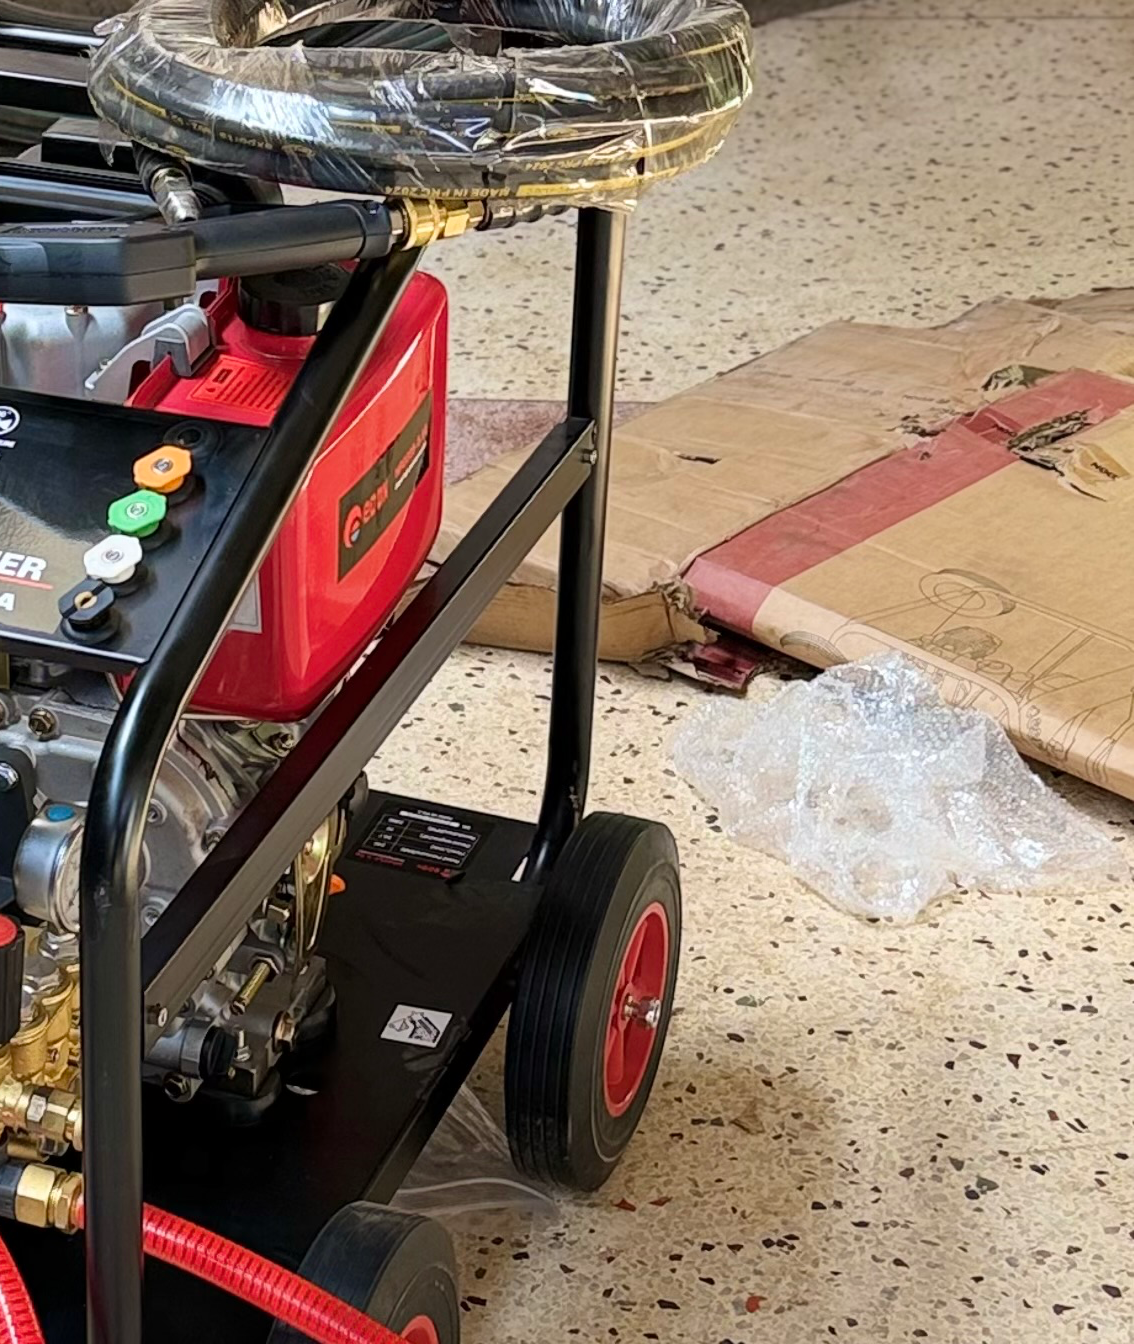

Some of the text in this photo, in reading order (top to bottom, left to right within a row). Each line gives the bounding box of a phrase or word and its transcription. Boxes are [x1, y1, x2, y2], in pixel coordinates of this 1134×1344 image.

[385, 186, 418, 196] 2024
[454, 187, 468, 197] IN
[471, 186, 512, 197] MADE
